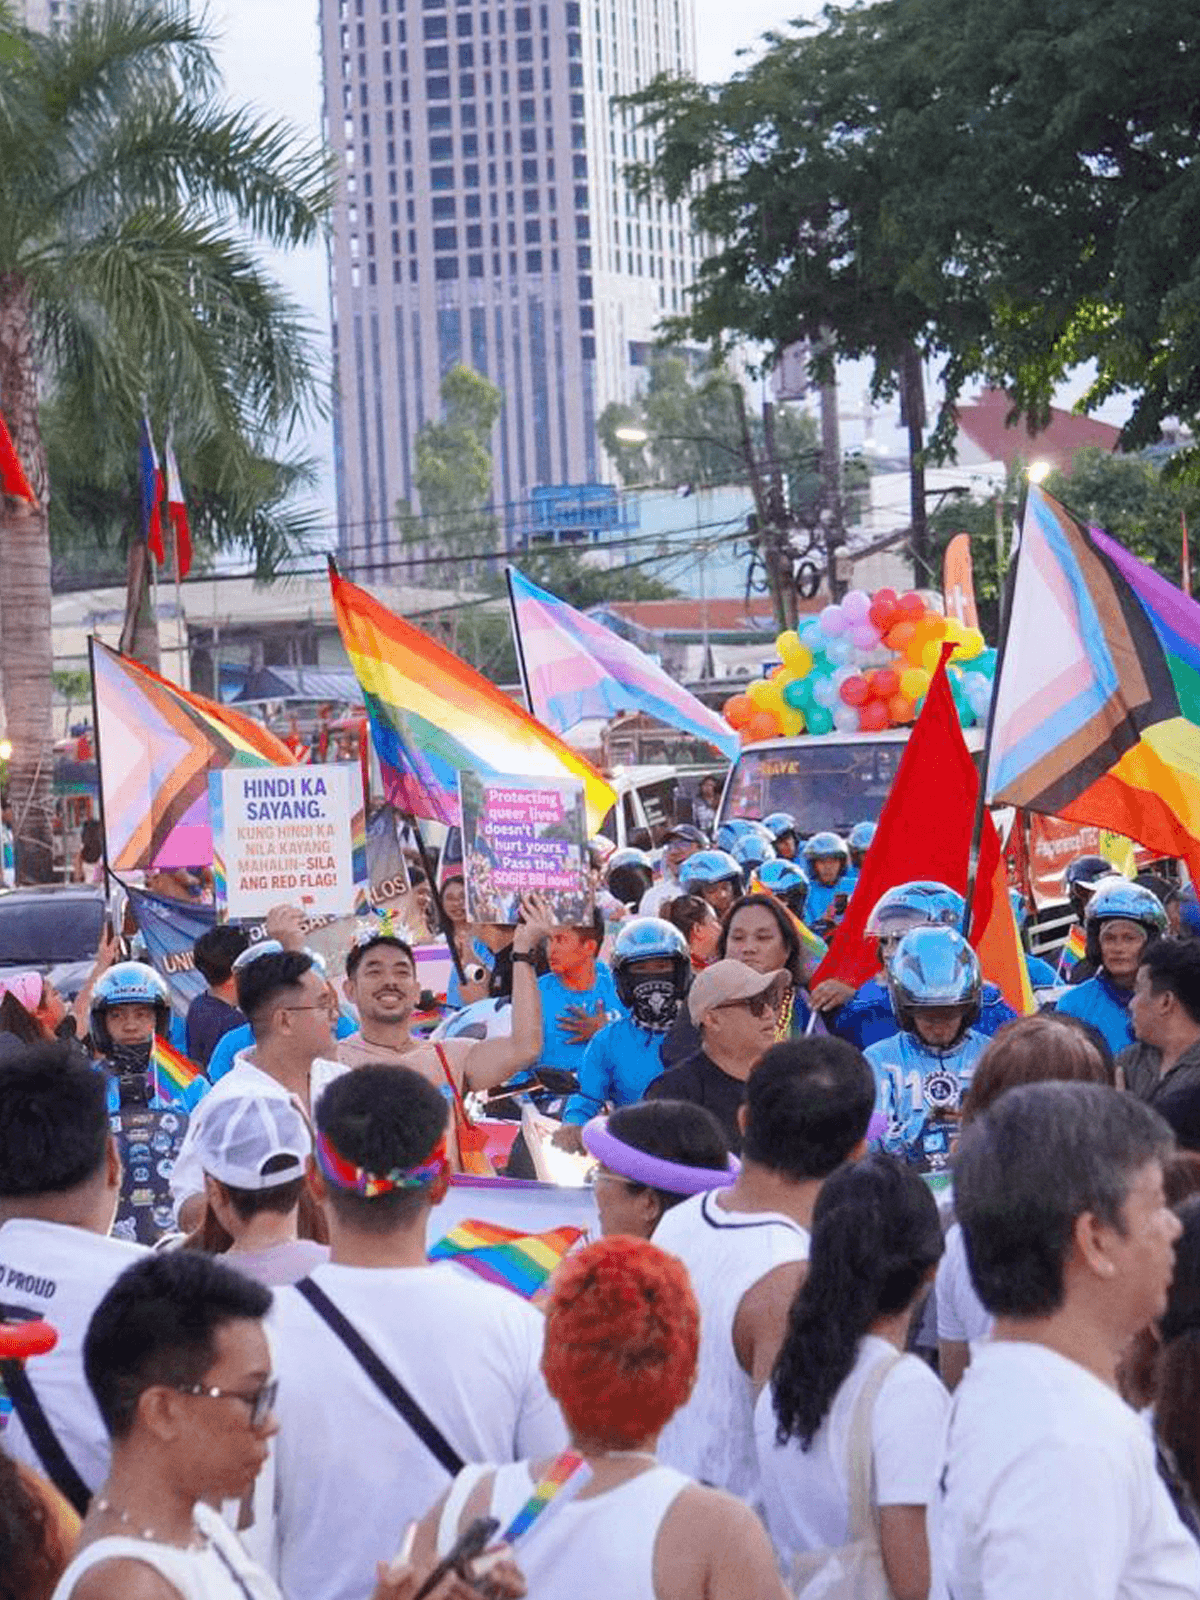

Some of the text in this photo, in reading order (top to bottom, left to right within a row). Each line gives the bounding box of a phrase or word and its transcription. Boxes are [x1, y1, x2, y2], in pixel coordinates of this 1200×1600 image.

[244, 778, 327, 798] HINDI KA
[489, 789, 558, 808] Protecting
[247, 800, 326, 820] SAYANG.
[489, 806, 560, 821] queer lives
[237, 823, 335, 840] KUNG HINDI KA
[485, 823, 531, 835] doesn't
[245, 841, 330, 856] NILA KAYANG
[494, 838, 522, 851] hurt
[502, 856, 556, 870] Pass the
[240, 873, 338, 889] ANG RED FLAG!
[371, 875, 407, 904] LOS
[6, 1268, 57, 1299] PROUD
